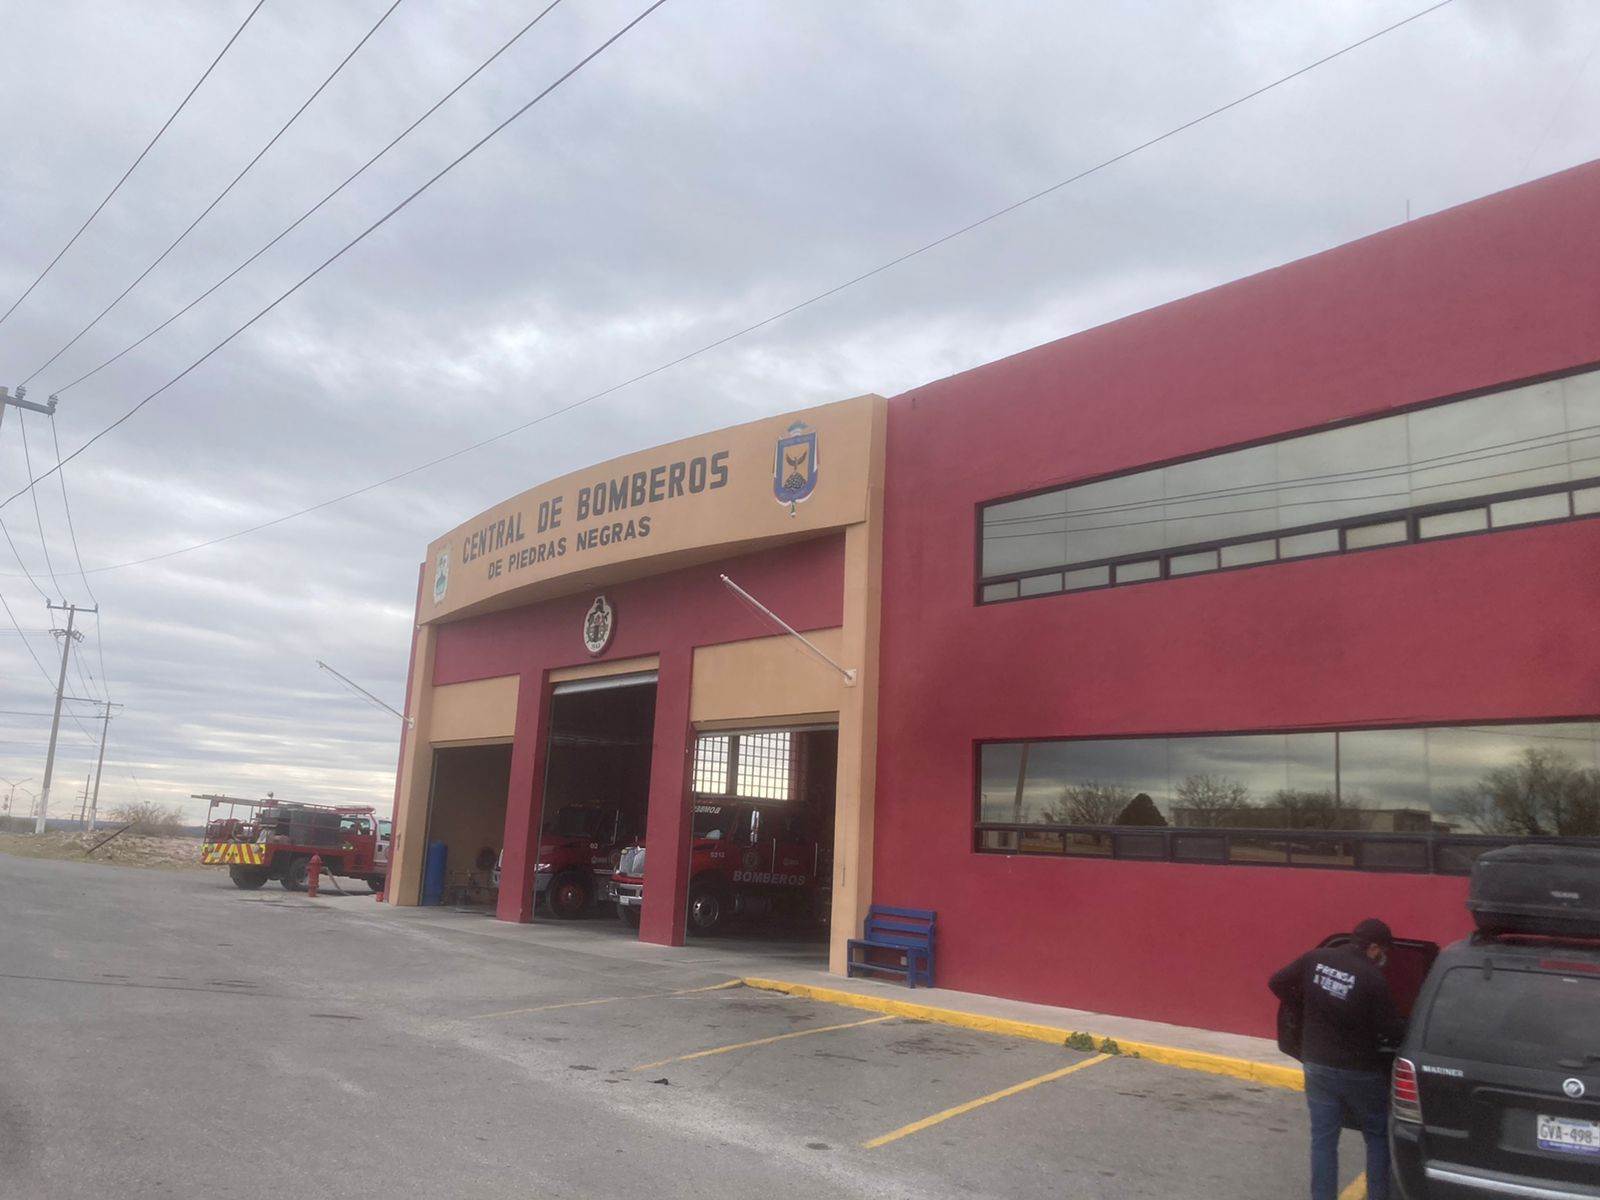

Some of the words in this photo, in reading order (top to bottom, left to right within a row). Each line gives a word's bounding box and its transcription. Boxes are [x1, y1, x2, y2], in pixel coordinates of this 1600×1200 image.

[463, 511, 525, 564] CENTRAL
[537, 495, 563, 534] DE
[576, 451, 729, 521] BOMBEROS
[488, 558, 502, 580] DE
[508, 536, 567, 573] PIEDRAS
[576, 516, 651, 551] NEGRAS
[733, 870, 806, 886] BOMBEROS
[1316, 963, 1356, 985] PRENSA
[1422, 1064, 1464, 1077] MARINER
[1540, 1123, 1600, 1144] GVA-498-
